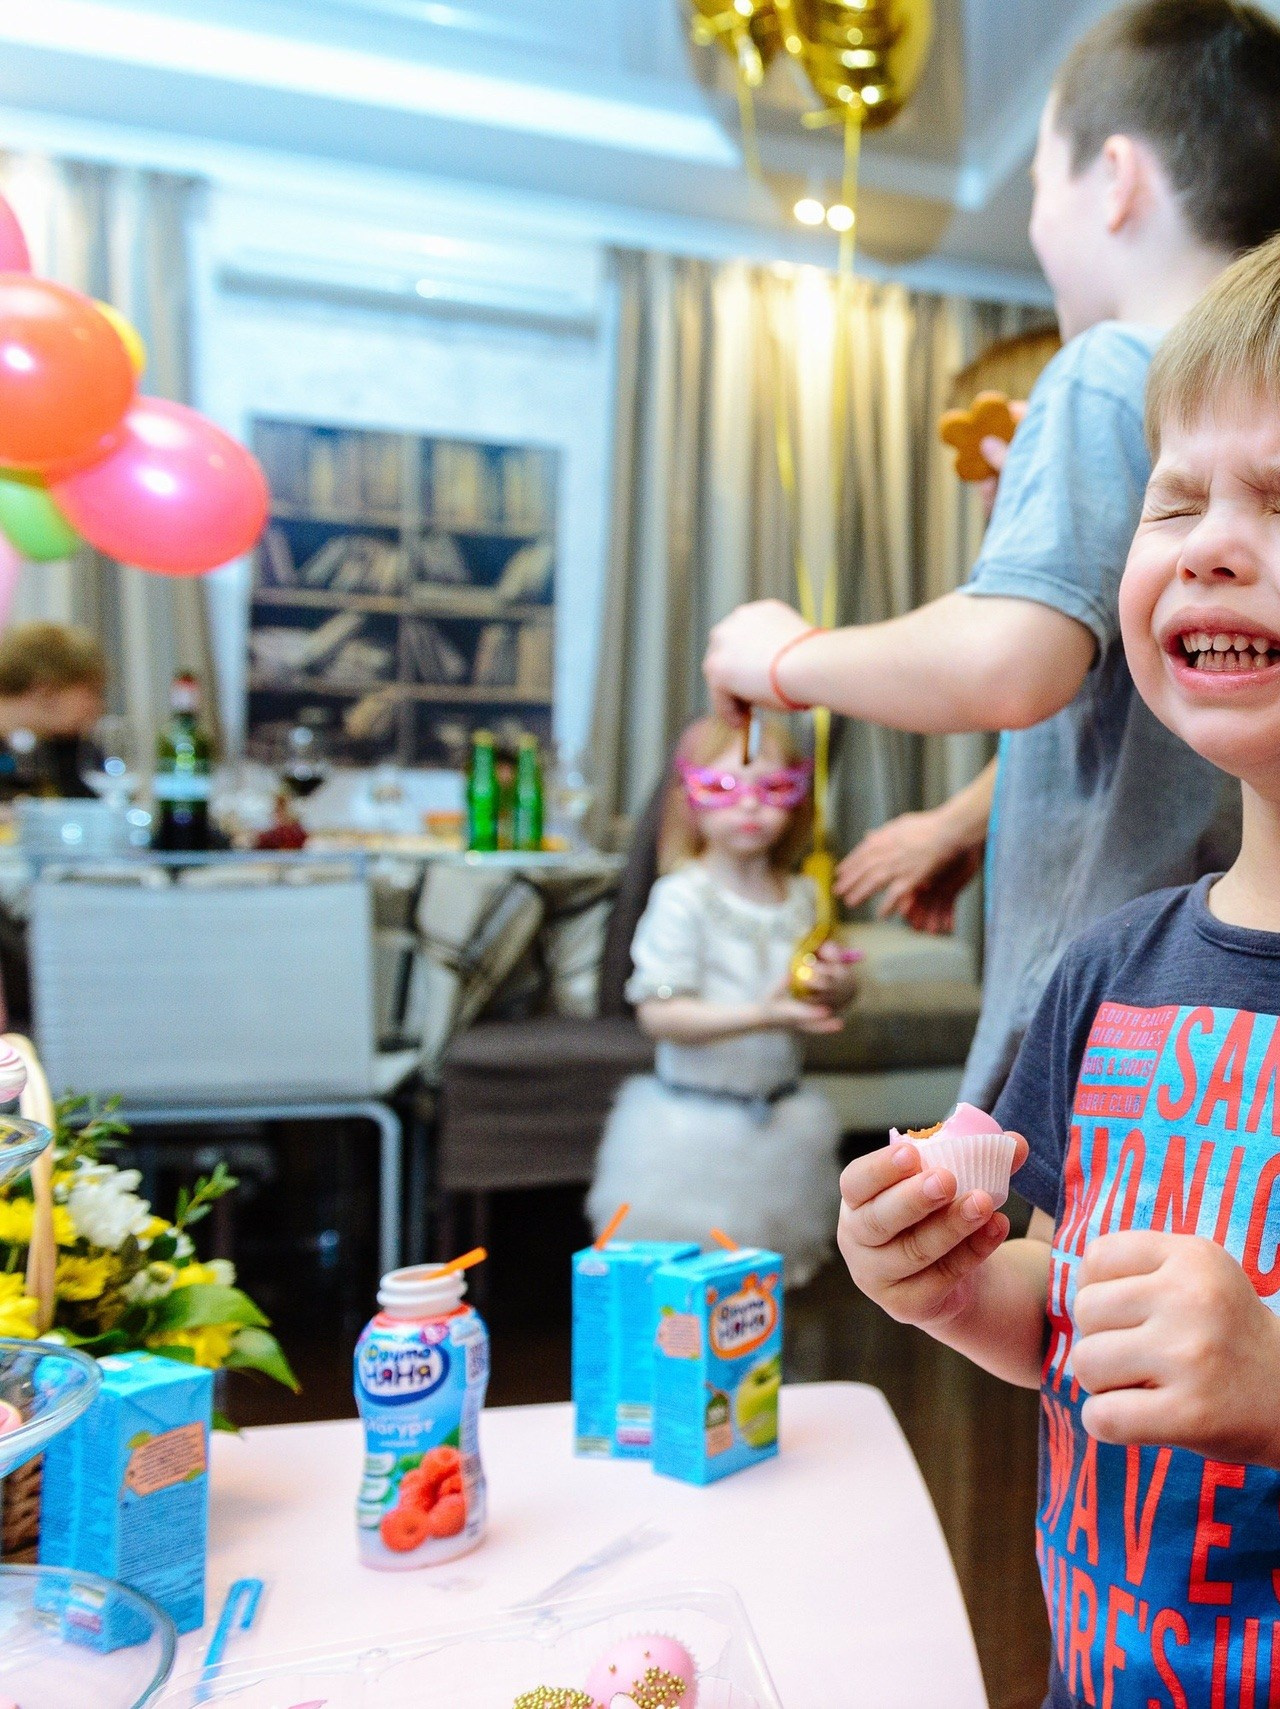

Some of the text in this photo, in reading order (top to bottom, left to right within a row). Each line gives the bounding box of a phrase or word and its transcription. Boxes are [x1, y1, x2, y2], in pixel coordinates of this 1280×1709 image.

[1099, 1007, 1141, 1028] SOUTH
[1091, 1026, 1163, 1046] HIGH TIDES
[1107, 1057, 1116, 1076] &
[1118, 1058, 1153, 1077] SONS
[1079, 1092, 1142, 1114] SURF CLUB
